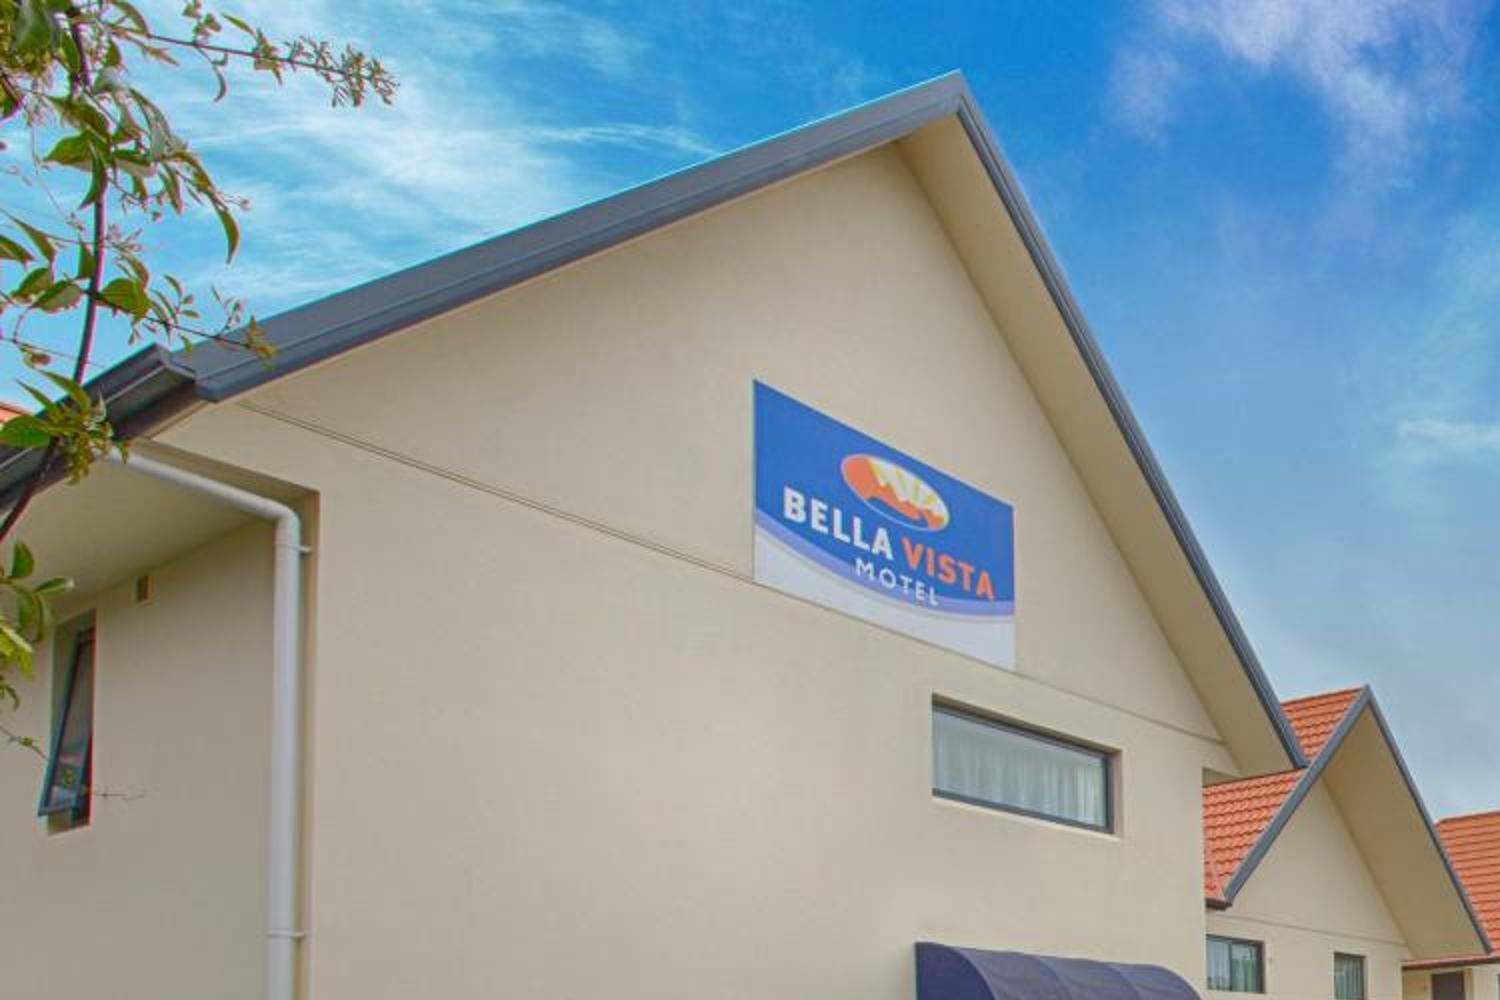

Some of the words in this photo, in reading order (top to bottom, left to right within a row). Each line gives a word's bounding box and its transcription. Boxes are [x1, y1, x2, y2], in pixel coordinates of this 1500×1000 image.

[783, 486, 894, 560] BELLA
[901, 537, 994, 600] VISTA
[854, 557, 939, 606] MOTEL
